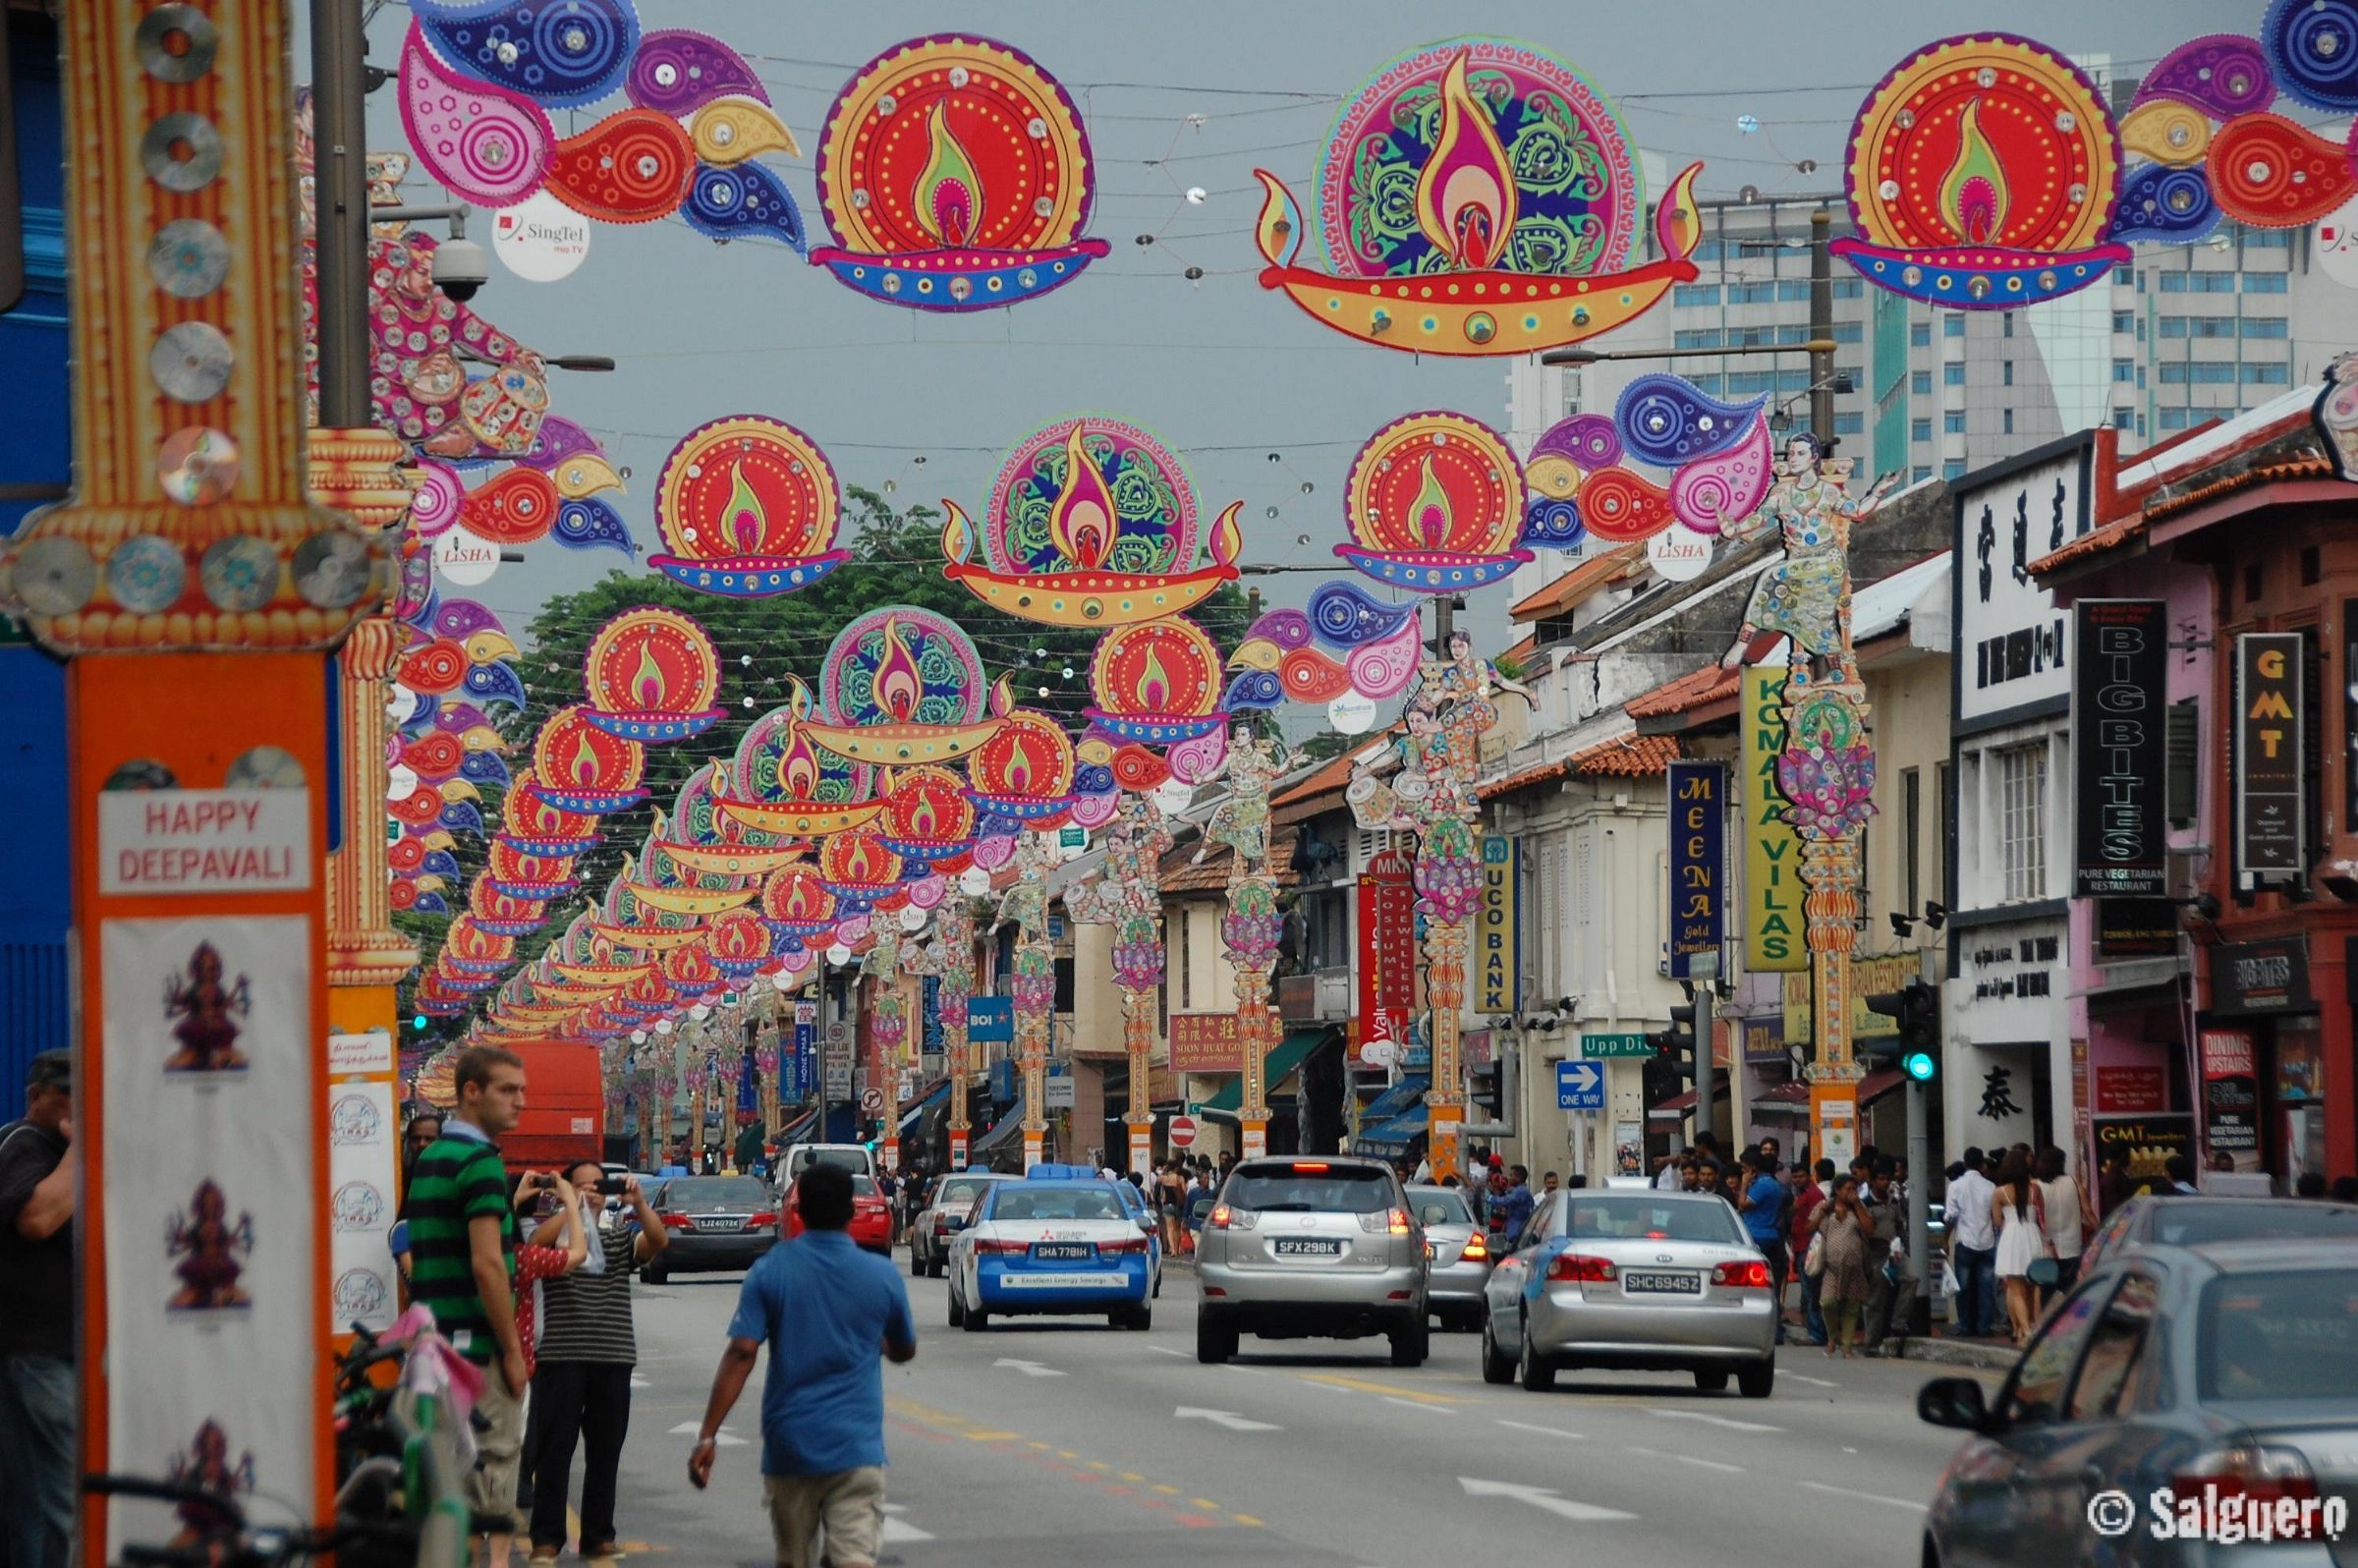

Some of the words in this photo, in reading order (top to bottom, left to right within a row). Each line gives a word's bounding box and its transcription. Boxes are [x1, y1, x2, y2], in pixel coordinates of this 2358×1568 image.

[528, 224, 583, 243] SingTel
[145, 800, 262, 834] HAPPY
[1678, 777, 1713, 918] MEENA
[118, 846, 292, 881] DEEPAVALI
[2078, 868, 2104, 879] PURE
[2105, 868, 2164, 879] VEGETARIAN
[2091, 881, 2153, 891] RESTAURANT
[1487, 870, 1504, 925] UCO
[1760, 839, 1792, 960] VILAS
[1382, 888, 1397, 978] COSTUME
[1684, 924, 1710, 940] Gold
[1397, 904, 1412, 1004] JEWELLERY
[1486, 932, 1504, 1008] BANK
[970, 1015, 992, 1026] BOI
[1175, 1042, 1200, 1054] SOON
[1203, 1042, 1225, 1053] HUAT
[1586, 1037, 1618, 1054] Upp
[2205, 1035, 2251, 1055] DINING
[2207, 1056, 2253, 1072] UPSTAIRS
[1560, 1093, 1579, 1105] ONE
[1583, 1093, 1600, 1104] WAY
[1977, 1065, 2023, 1121] 泰
[2220, 1115, 2239, 1124] PURE
[2101, 1124, 2146, 1144] GMT
[2210, 1126, 2255, 1136] VEGETARIAN
[2211, 1137, 2256, 1147] RESTAURANT
[1279, 1242, 1335, 1254] SFX298K
[1627, 1275, 1700, 1290] SHC6945Z
